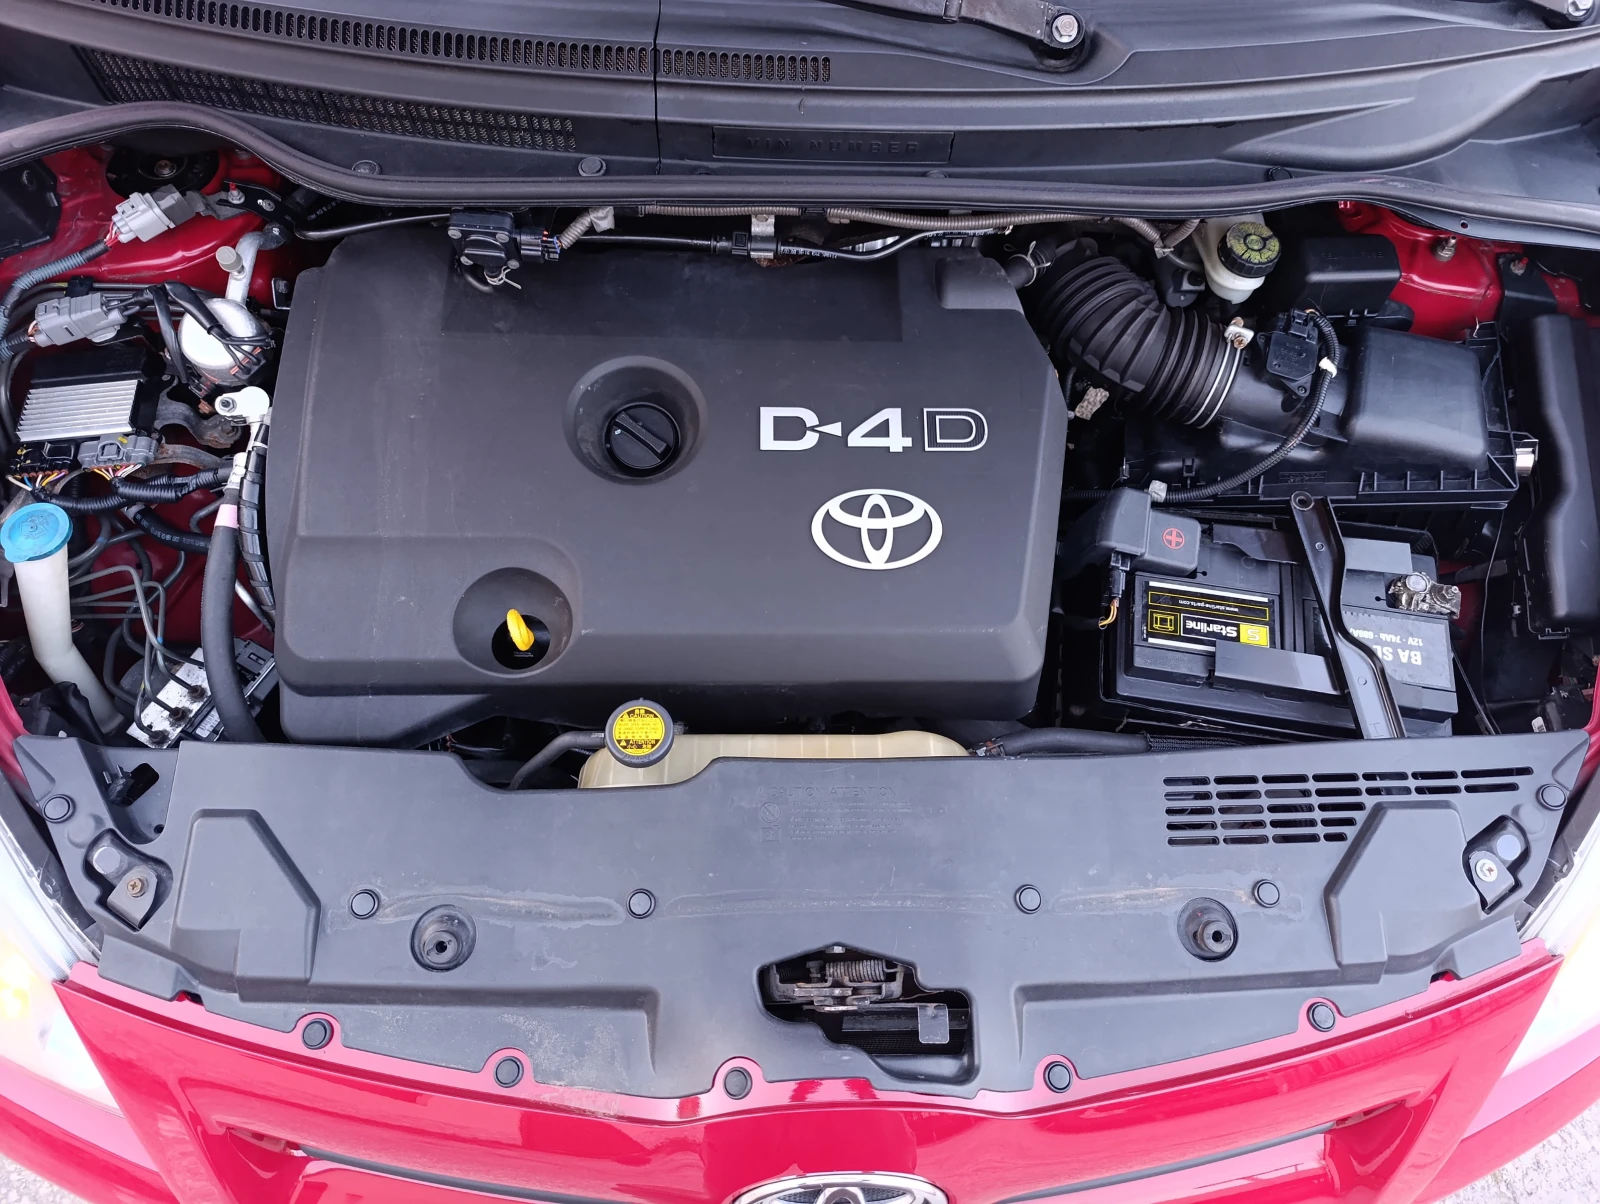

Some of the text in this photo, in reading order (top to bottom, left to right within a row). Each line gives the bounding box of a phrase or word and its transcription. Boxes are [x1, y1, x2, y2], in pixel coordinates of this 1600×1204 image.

[747, 138, 919, 153] VIN NUMBER
[1185, 619, 1238, 638] Starline
[1379, 632, 1401, 643] 74Ah
[1407, 637, 1424, 646] 12V
[1397, 648, 1422, 665] BA
[769, 786, 896, 797] CAUTION ATTENTION
